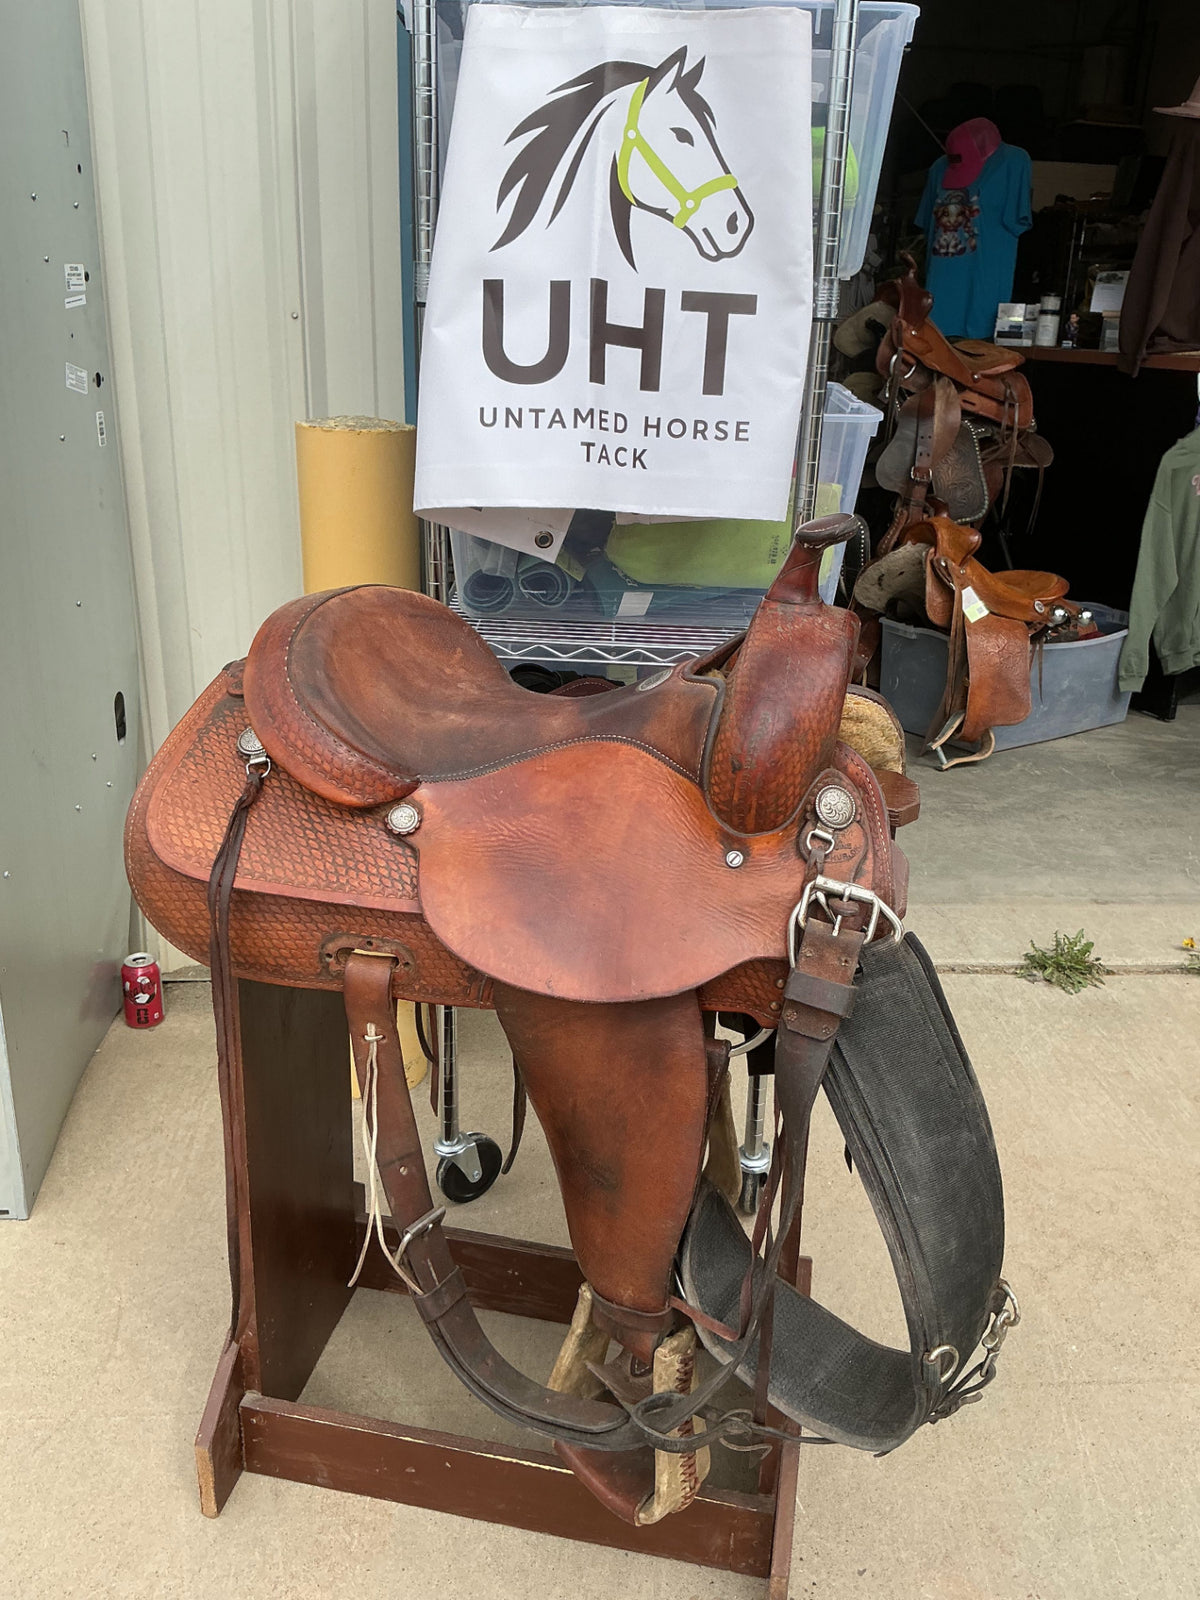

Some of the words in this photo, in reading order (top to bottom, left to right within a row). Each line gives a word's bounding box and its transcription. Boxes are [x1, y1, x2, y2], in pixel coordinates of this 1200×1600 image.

[482, 277, 758, 396] UHT
[479, 406, 628, 434] UNTAMED
[643, 416, 750, 442] HORSE
[580, 441, 648, 470] TACK
